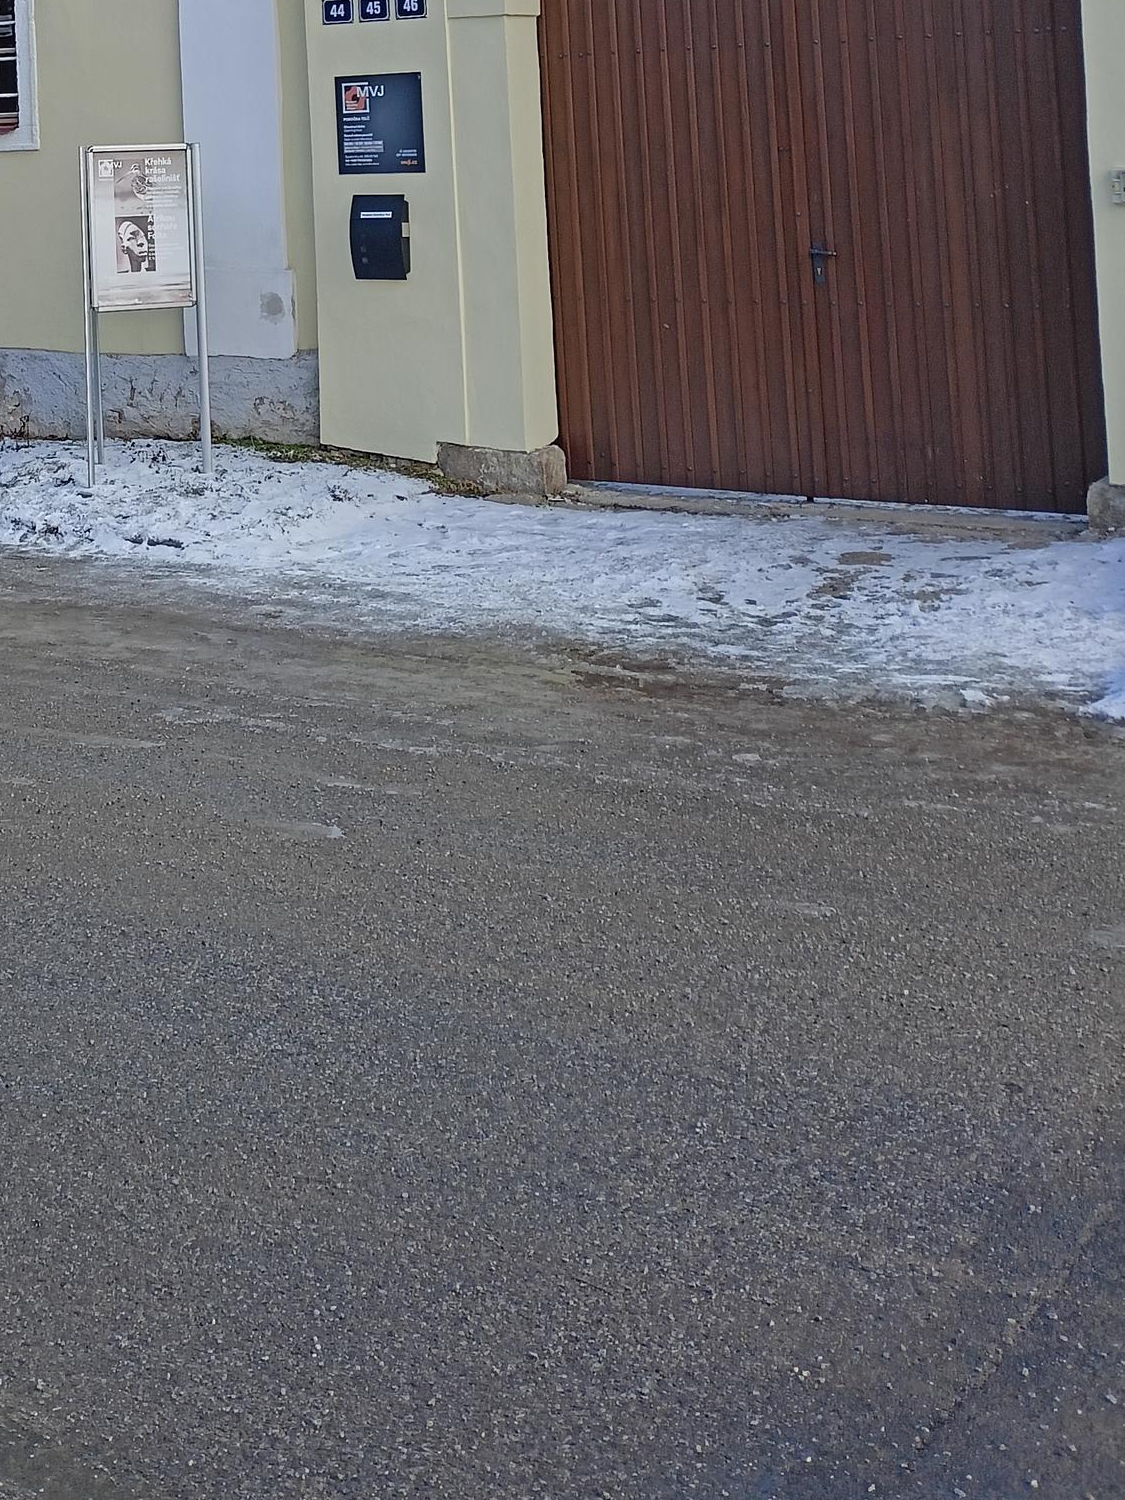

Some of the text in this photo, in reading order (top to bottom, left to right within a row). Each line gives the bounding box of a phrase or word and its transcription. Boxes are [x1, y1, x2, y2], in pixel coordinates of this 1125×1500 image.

[330, 4, 345, 17] 44
[366, 1, 381, 15] 45
[356, 85, 385, 97] MVJ
